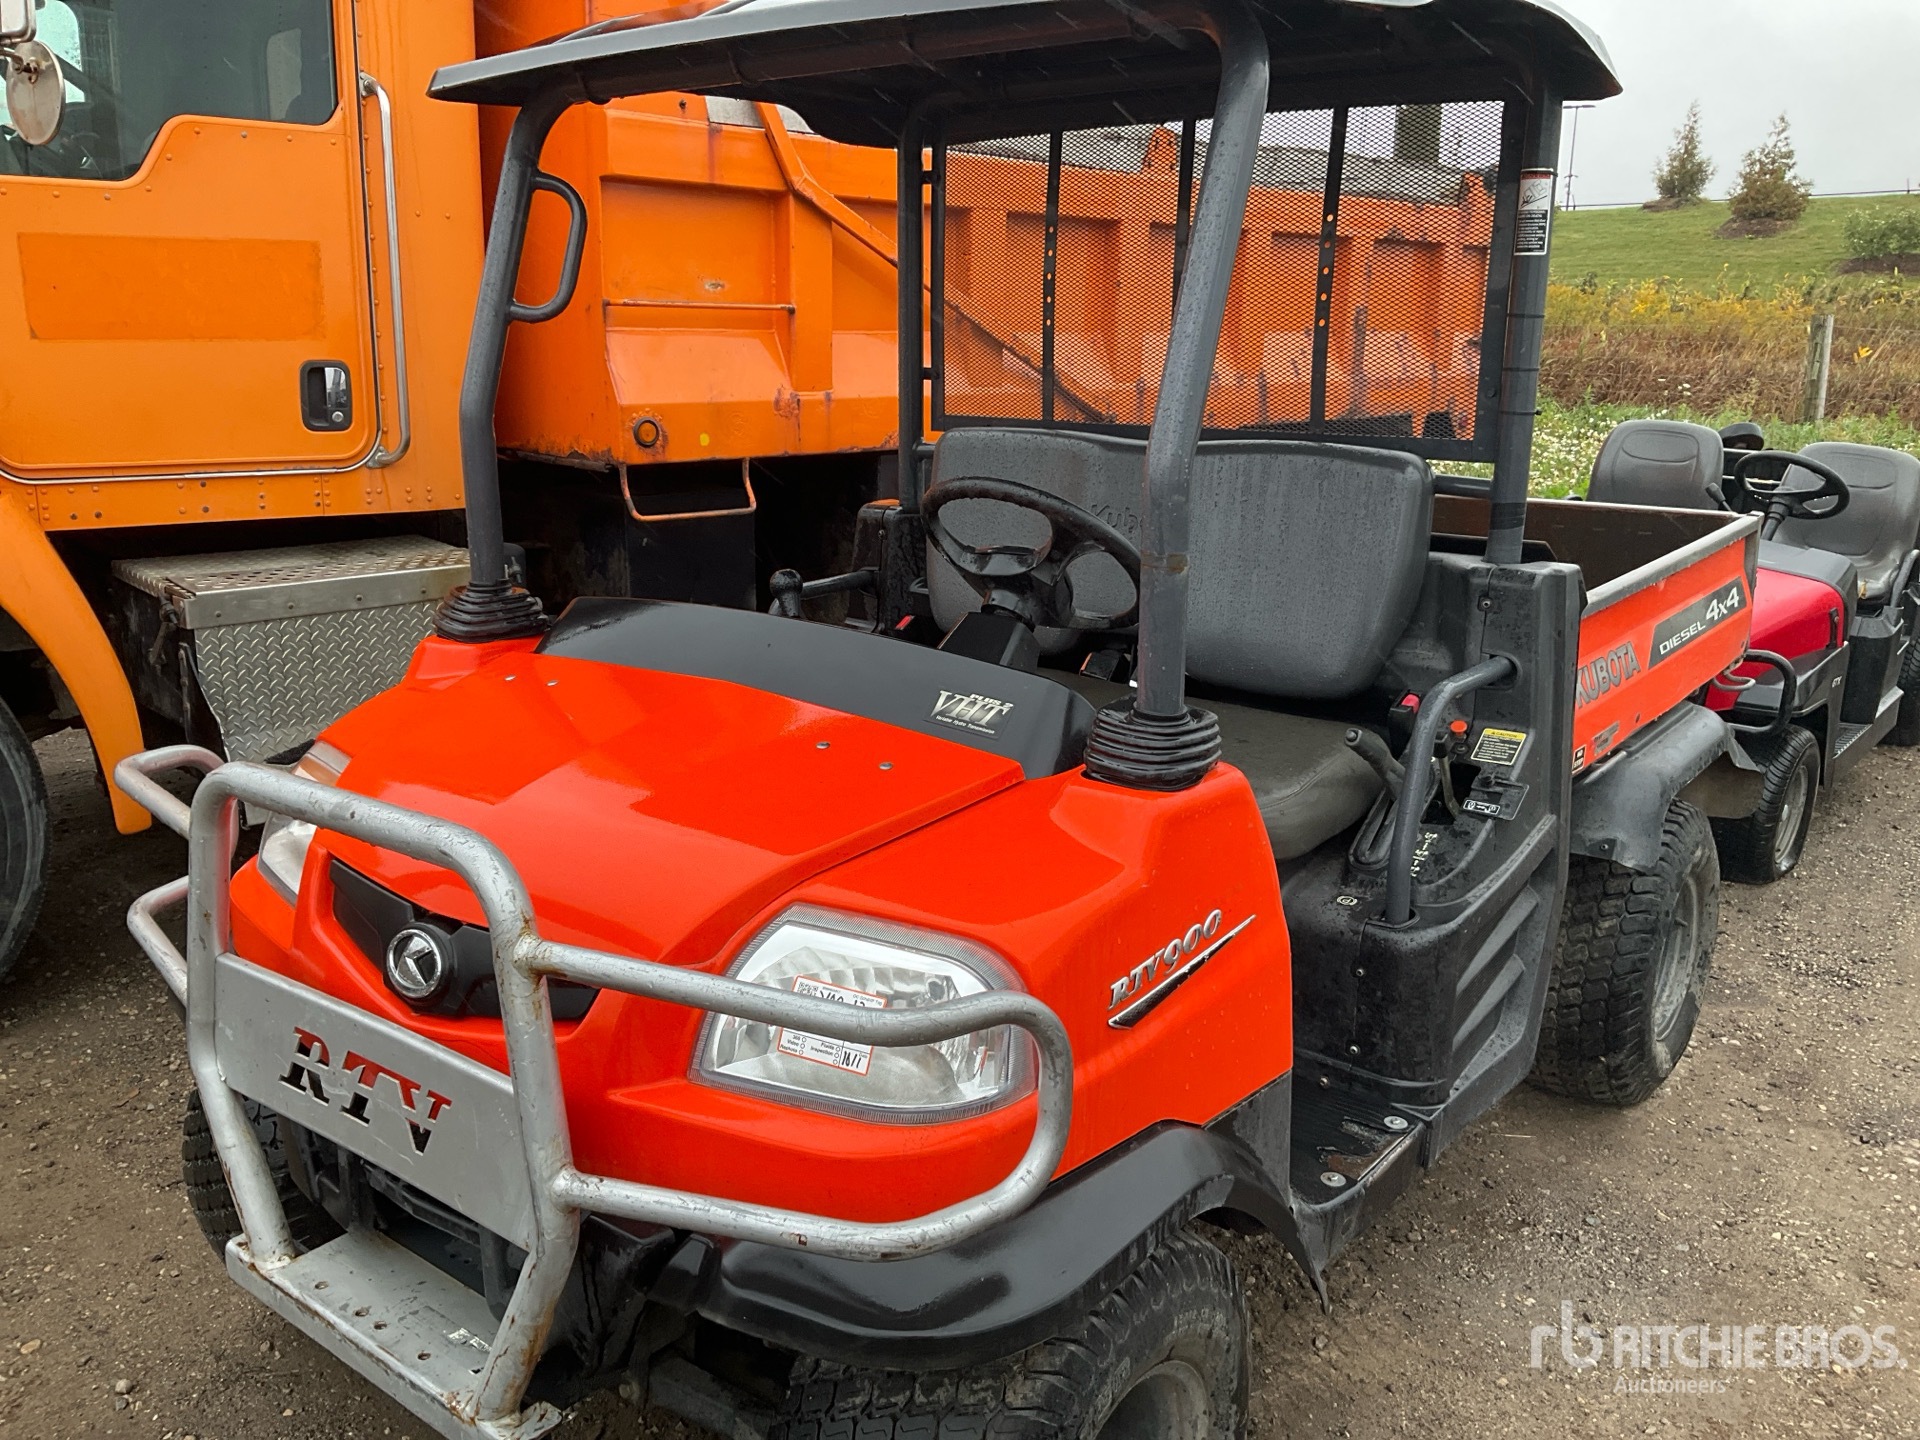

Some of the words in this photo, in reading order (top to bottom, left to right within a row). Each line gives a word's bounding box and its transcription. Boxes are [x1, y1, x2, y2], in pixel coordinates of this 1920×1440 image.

[1659, 621, 1706, 655] DIESEL
[1706, 587, 1739, 621] 4x4
[930, 690, 1011, 726] VHT
[969, 693, 1001, 705] PLUS
[1575, 641, 1641, 708] KUBOTA
[1108, 909, 1222, 1010] RTV900
[278, 1026, 453, 1156] RTV
